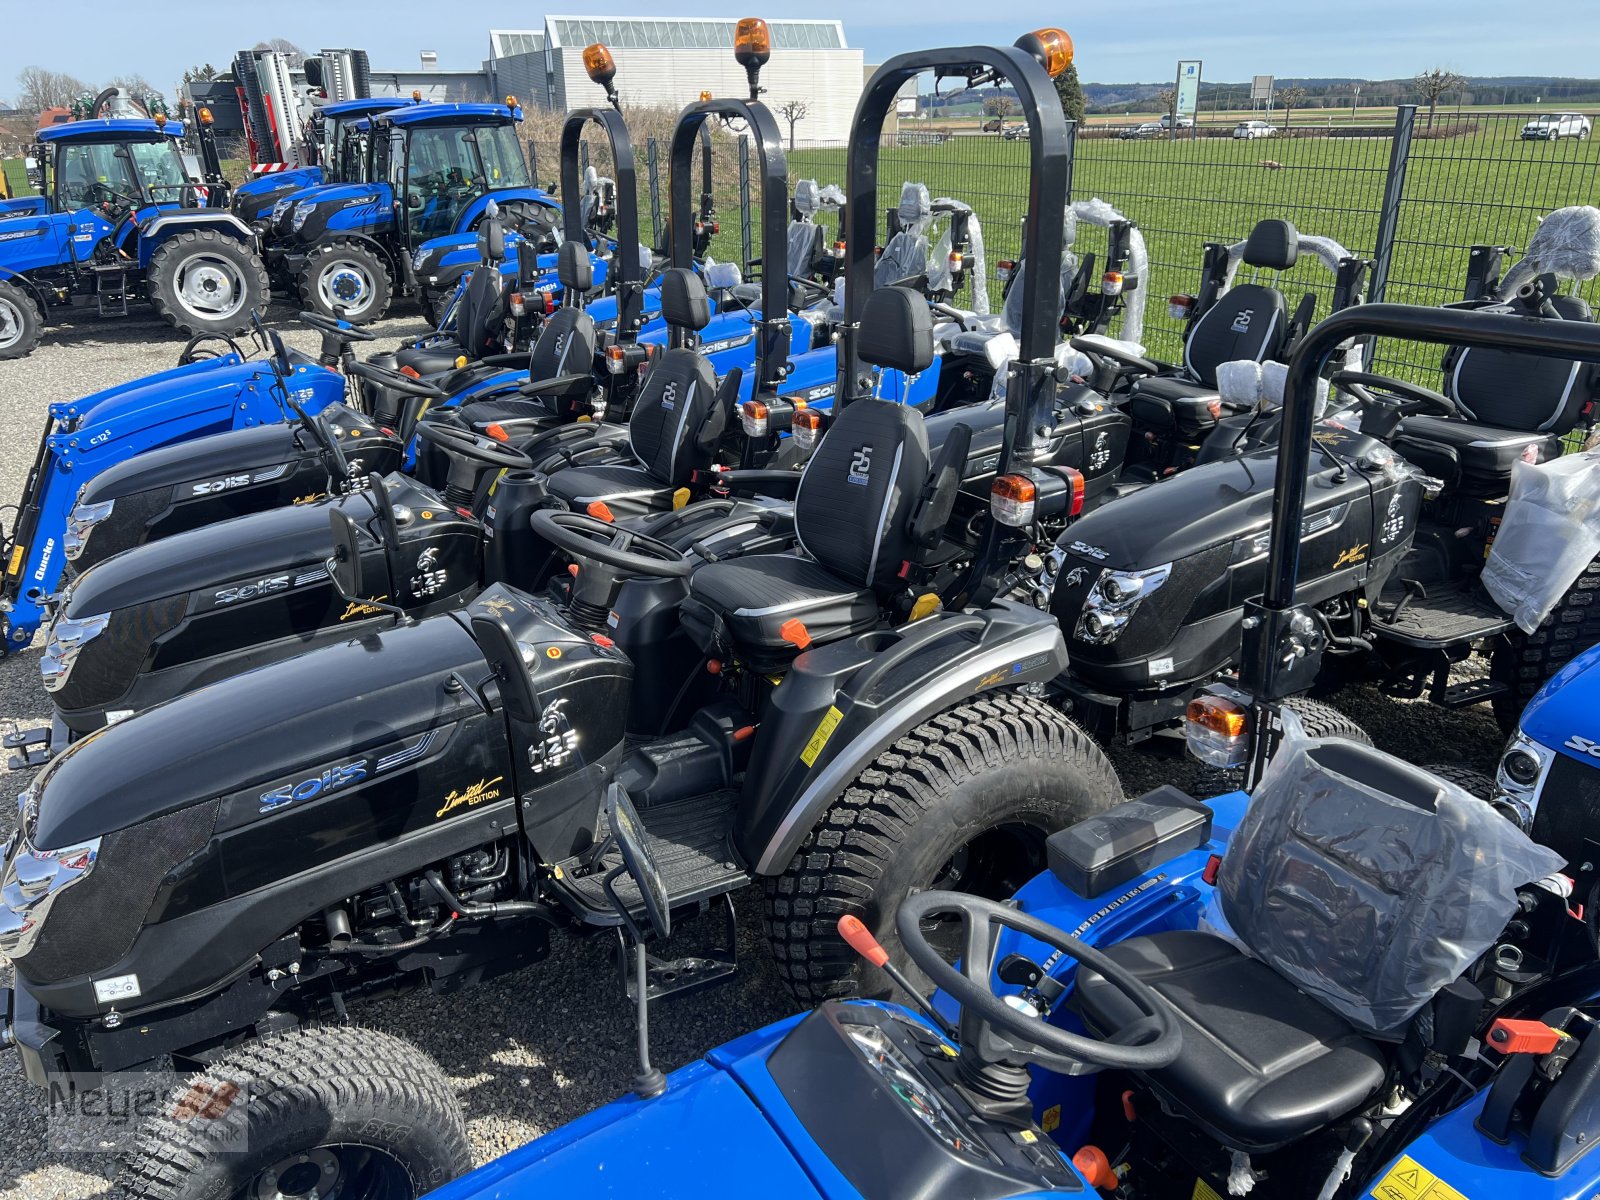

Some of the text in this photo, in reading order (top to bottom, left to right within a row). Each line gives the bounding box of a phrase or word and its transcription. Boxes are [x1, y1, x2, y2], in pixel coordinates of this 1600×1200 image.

[34, 537, 55, 581] Quicke
[436, 776, 503, 818] Limited EDITION
